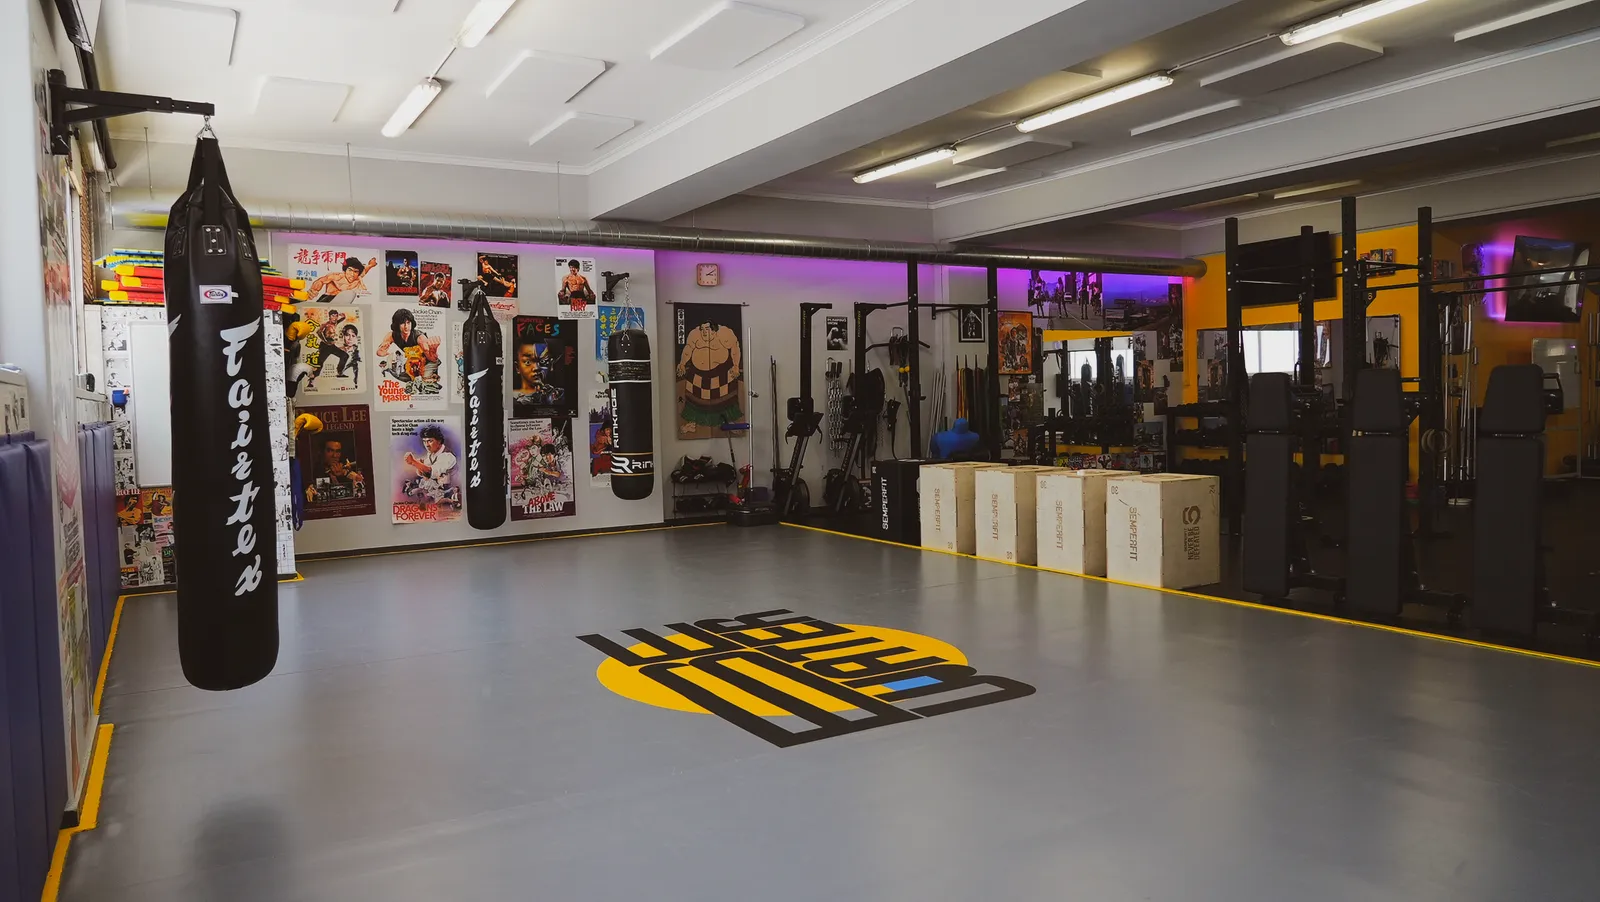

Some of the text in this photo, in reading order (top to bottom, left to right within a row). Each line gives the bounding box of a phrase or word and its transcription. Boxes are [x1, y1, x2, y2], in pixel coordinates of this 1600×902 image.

[517, 322, 560, 337] FACES
[378, 385, 405, 396] Young
[383, 379, 400, 388] The
[382, 393, 412, 403] Master
[341, 406, 367, 422] LEE
[611, 388, 620, 449] RINKAGE
[467, 368, 489, 488] Fairtex
[220, 316, 262, 597] Fairtex
[522, 501, 564, 515] THE LAW
[880, 476, 889, 531] SEMPERFIT
[395, 511, 437, 521] FOREVER
[991, 493, 999, 541] SEMPERFIT
[1055, 499, 1064, 551] SEMPERFIT
[1188, 527, 1194, 537] BE
[1129, 506, 1139, 562] SEMPERFIT
